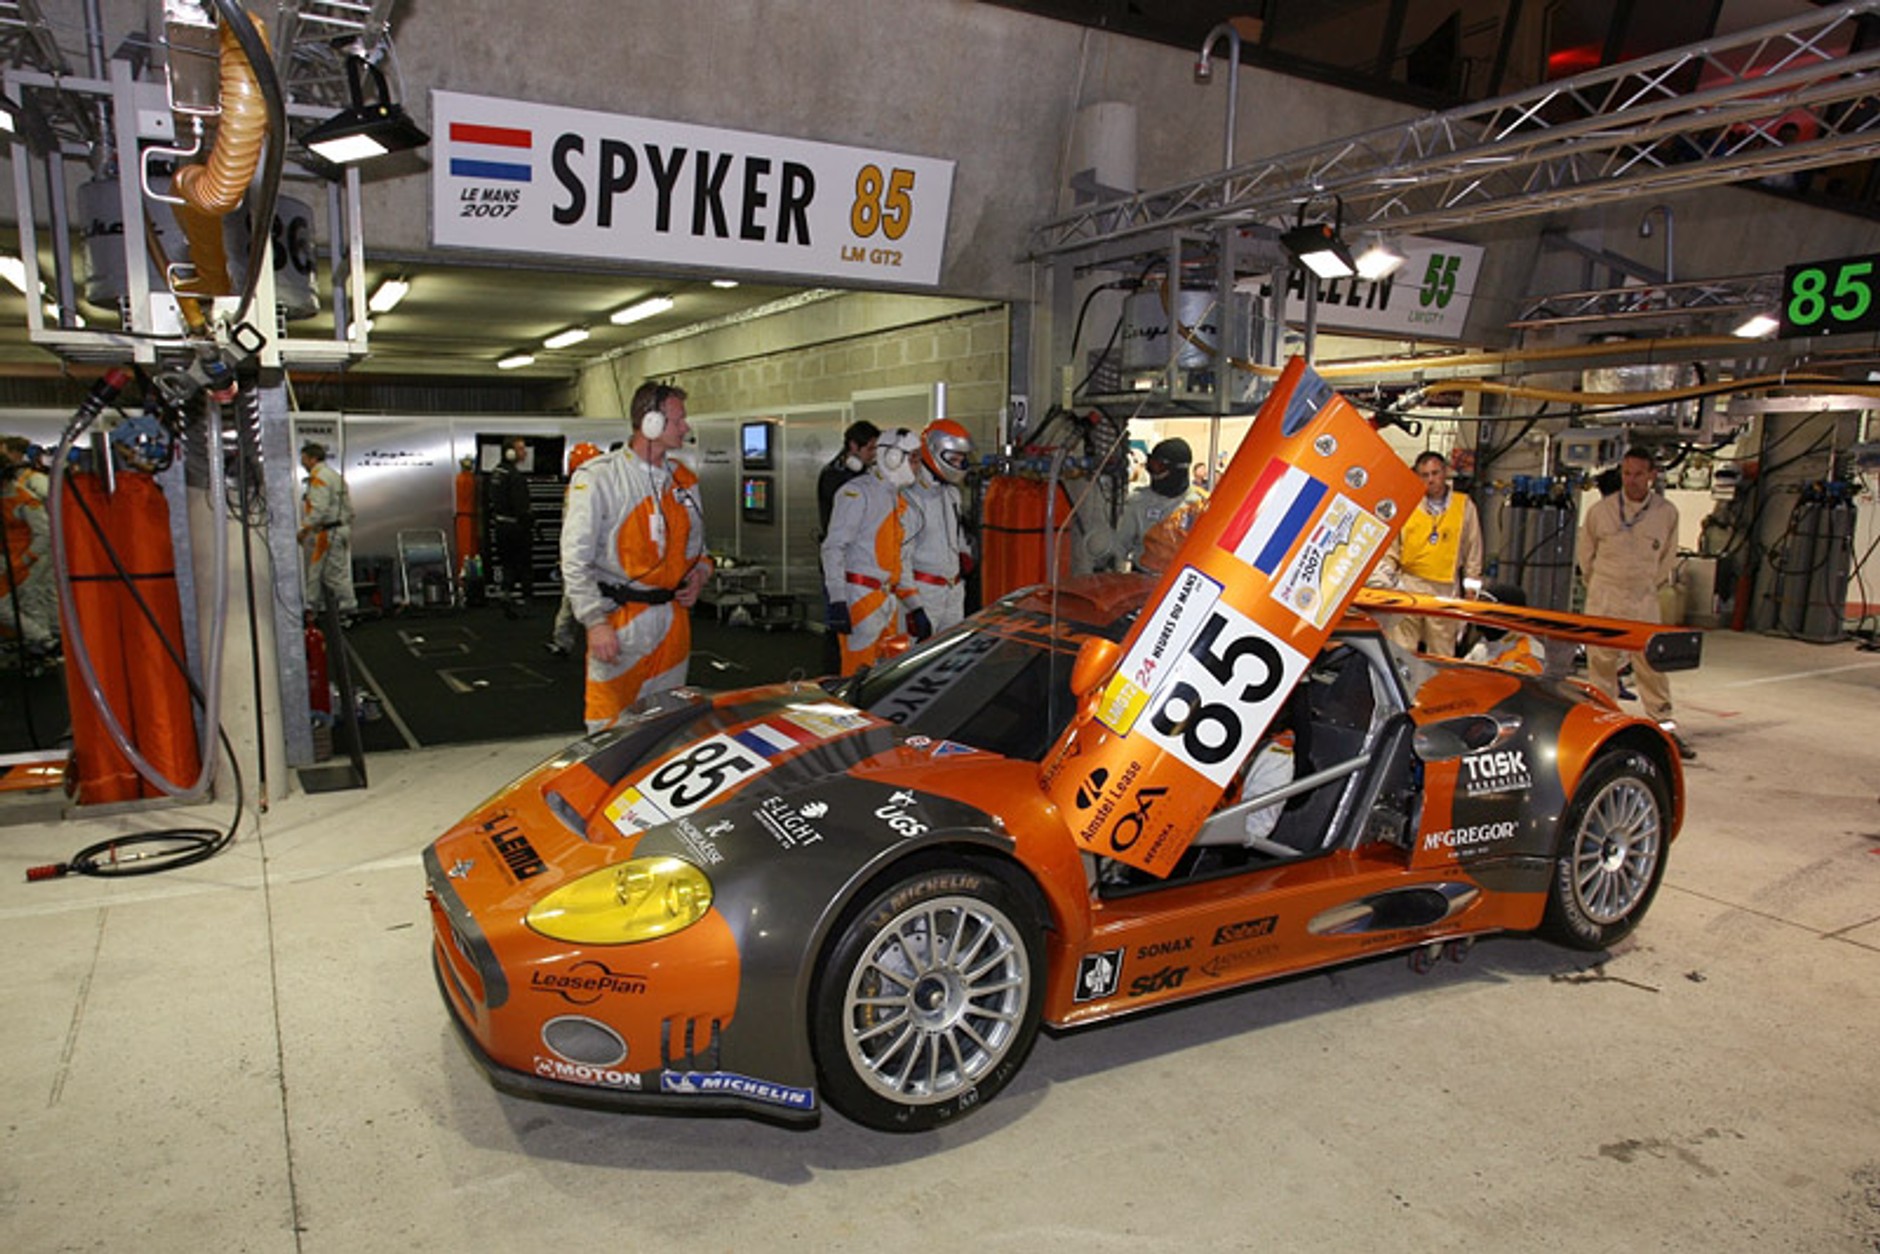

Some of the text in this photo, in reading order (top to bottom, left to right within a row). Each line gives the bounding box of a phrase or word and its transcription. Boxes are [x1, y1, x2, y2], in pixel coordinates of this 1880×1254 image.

[461, 187, 520, 203] LE MANS
[551, 133, 815, 246] SPYKER
[850, 164, 916, 240] 85
[460, 203, 518, 218] 2007
[841, 244, 904, 267] LM GT2
[1419, 253, 1461, 308] 55
[1788, 262, 1873, 326] 85
[1301, 548, 1320, 583] 2007
[1135, 573, 1198, 689] 24 HEURES DU MANS
[1151, 612, 1284, 765] 85
[650, 740, 755, 809] 85
[1463, 751, 1527, 780] TASK
[1080, 761, 1141, 842] Amstel Lease
[874, 805, 929, 837] UGS
[890, 874, 980, 912] MICHELIN
[1137, 936, 1194, 959] SONAX
[531, 970, 646, 994] LeasePlan
[554, 1061, 641, 1086] MOTON
[701, 1076, 806, 1104] MICHELIN
